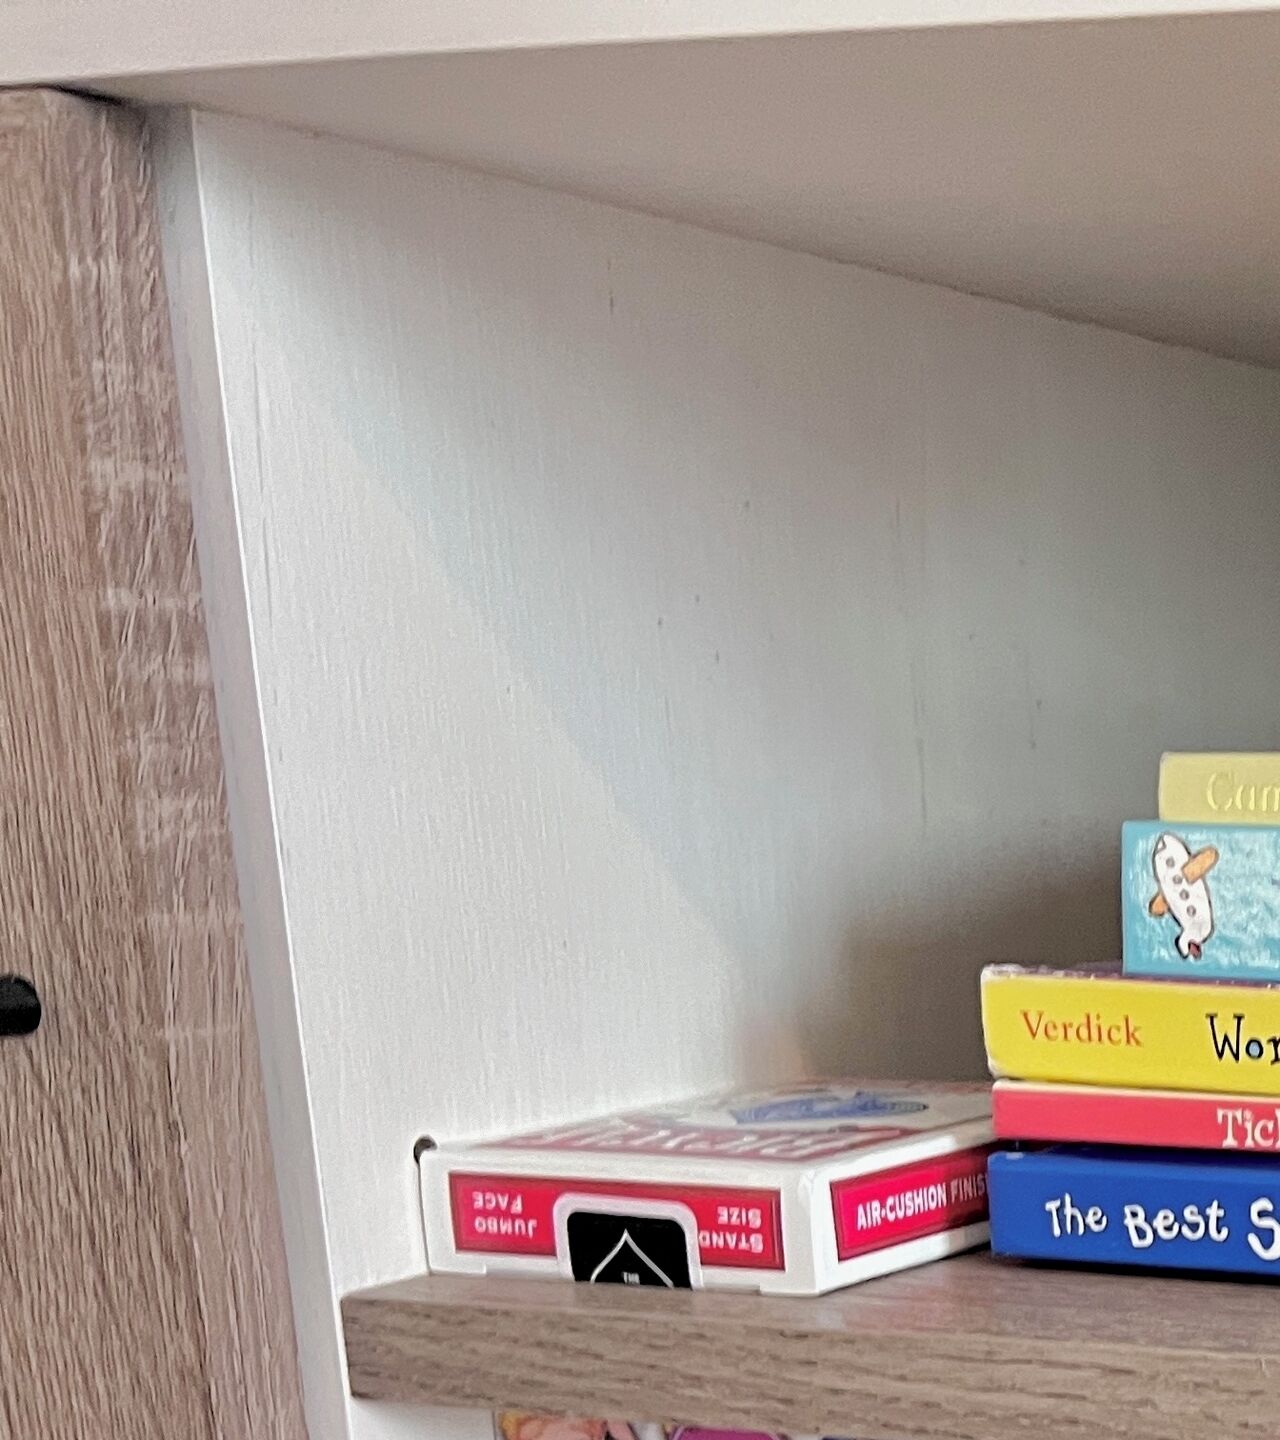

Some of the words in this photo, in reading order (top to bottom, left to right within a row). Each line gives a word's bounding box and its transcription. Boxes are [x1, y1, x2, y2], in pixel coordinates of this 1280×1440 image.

[1020, 1008, 1143, 1048] Verdick
[472, 1191, 523, 1215] FACE
[717, 1206, 762, 1228] SIZE
[856, 1182, 948, 1232] AIR-CUSHION
[950, 1171, 988, 1204] FINIS
[474, 1216, 538, 1238] JUMBO
[1044, 1192, 1108, 1239] The
[1121, 1199, 1230, 1250] Best
